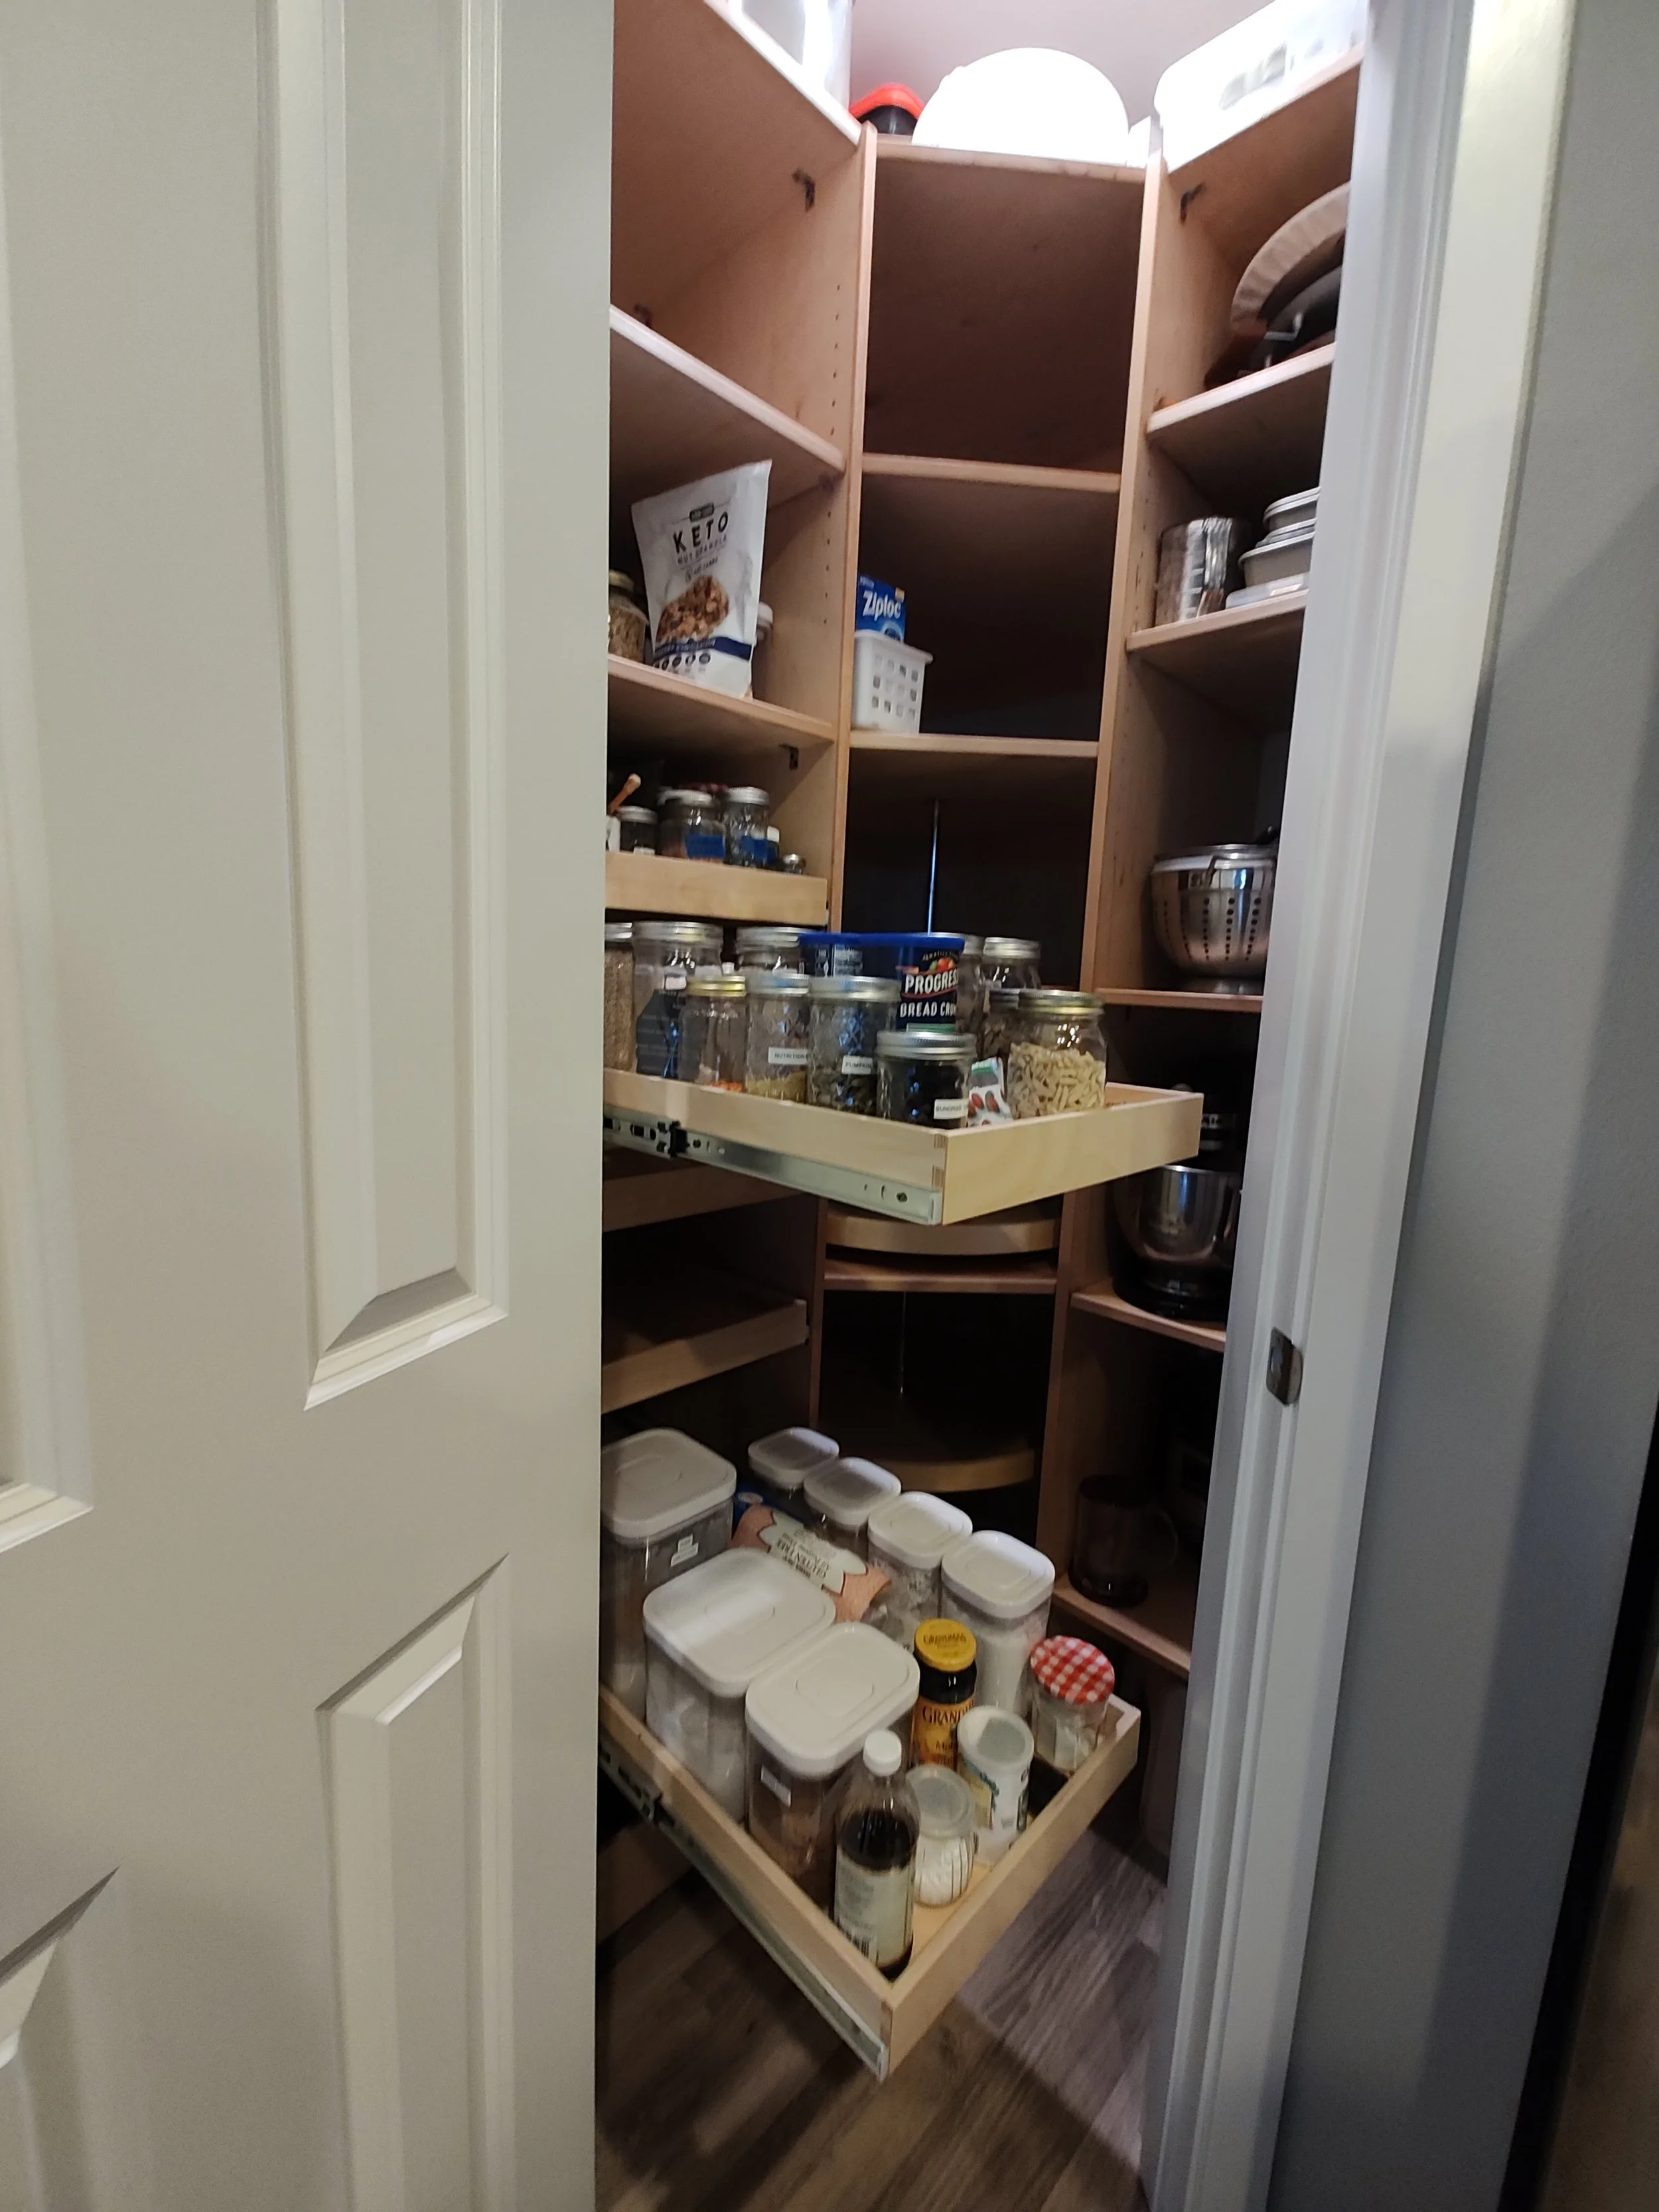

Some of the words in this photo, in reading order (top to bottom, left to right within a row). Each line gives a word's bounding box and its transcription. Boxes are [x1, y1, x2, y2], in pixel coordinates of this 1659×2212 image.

[673, 511, 729, 553] KETO
[863, 590, 902, 622] Ziploc
[904, 968, 959, 995] PROGRES
[900, 1001, 938, 1017] BREAD
